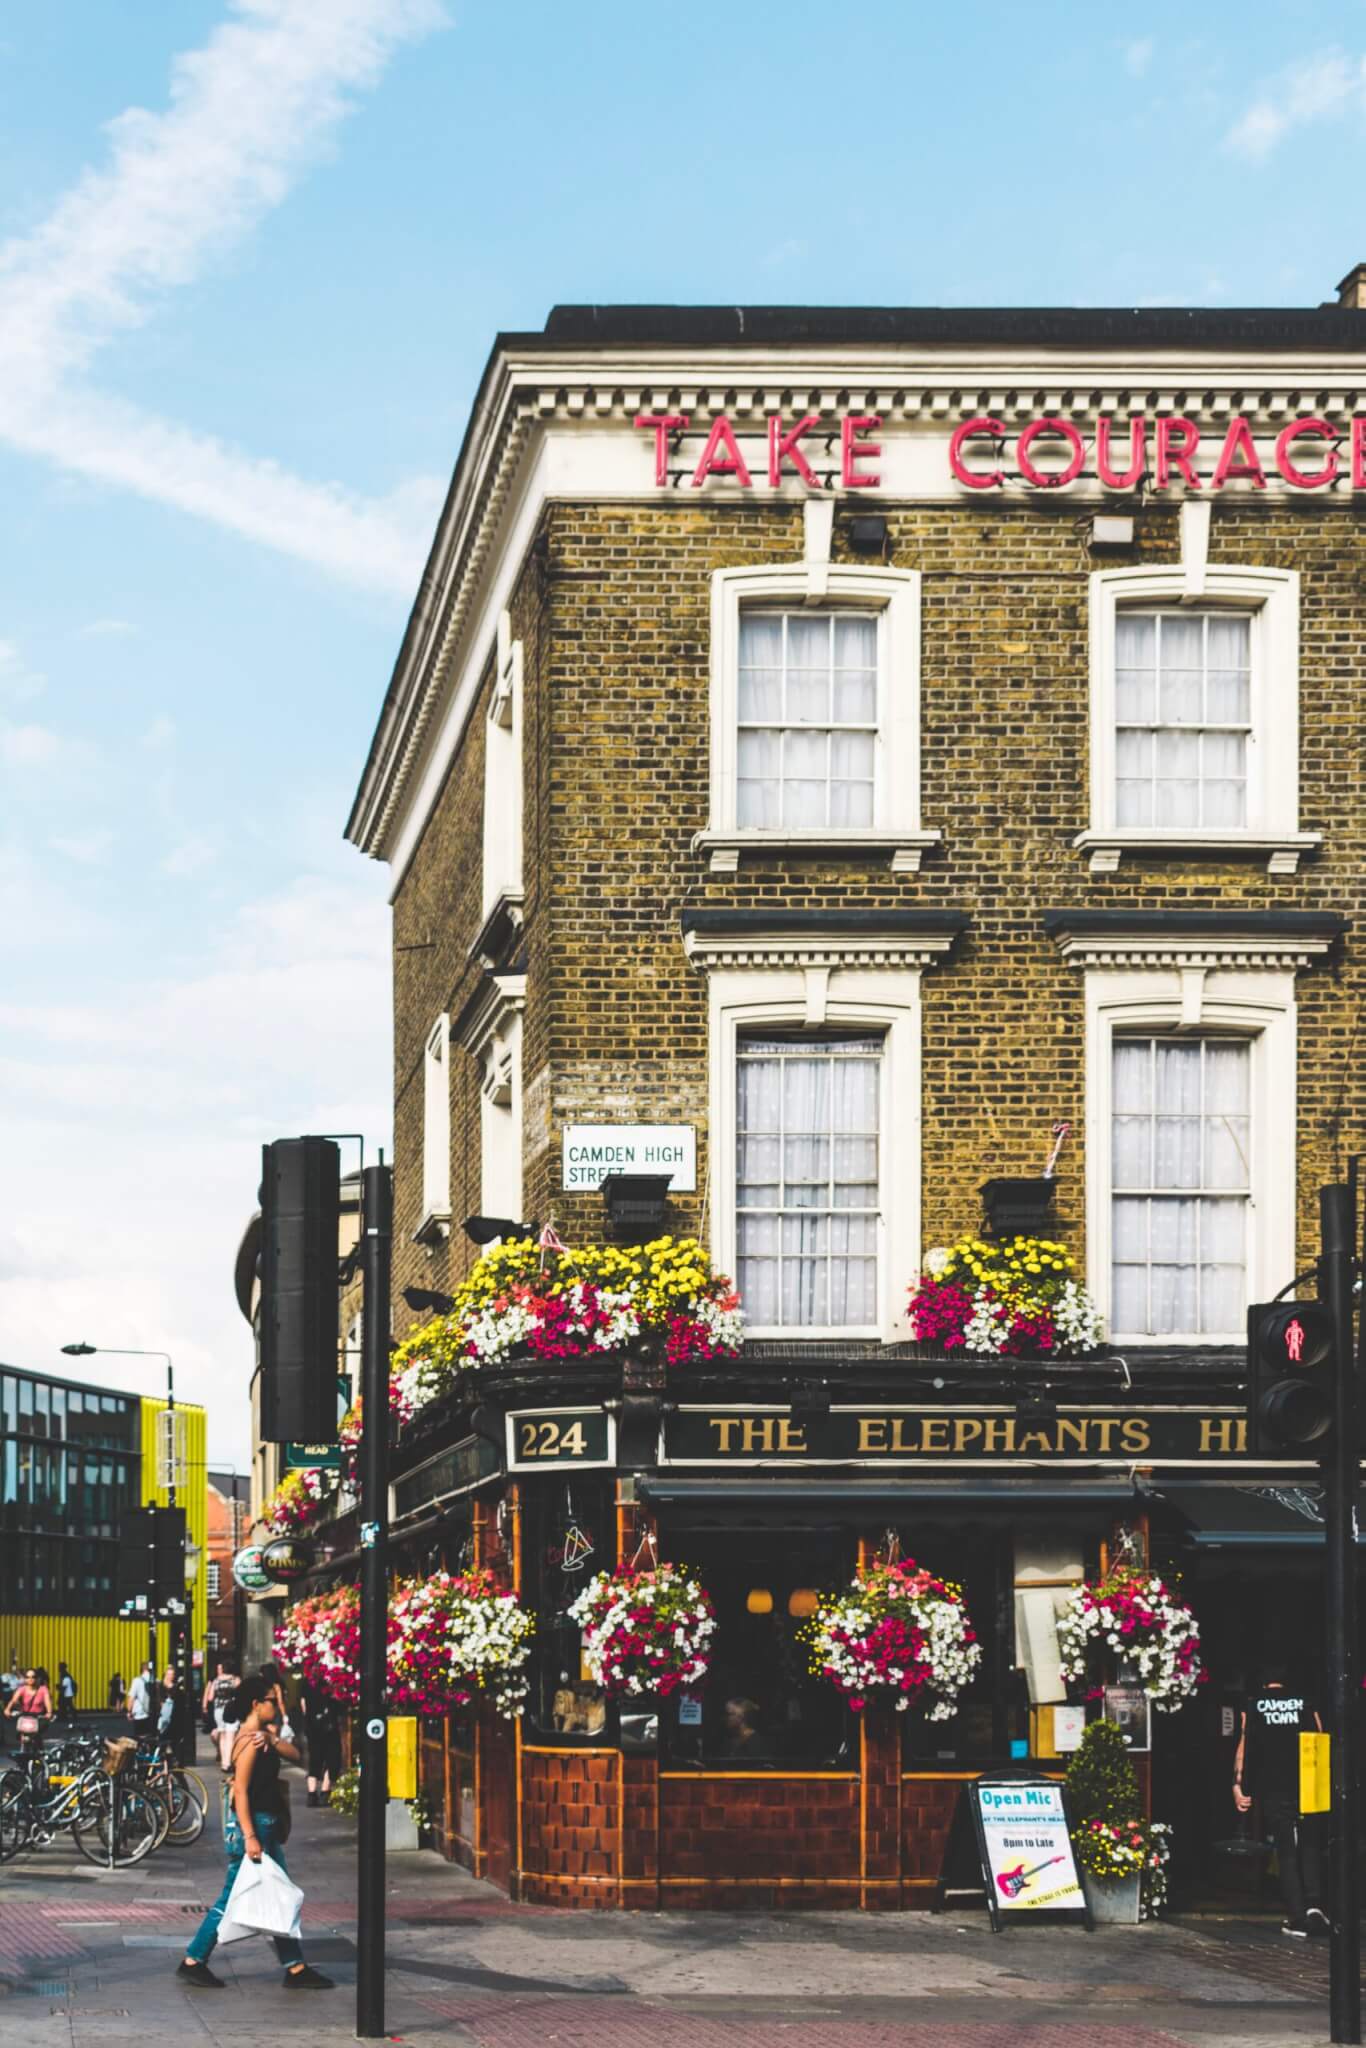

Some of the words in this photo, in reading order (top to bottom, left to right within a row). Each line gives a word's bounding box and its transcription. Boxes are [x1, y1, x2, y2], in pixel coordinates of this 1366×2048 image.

[634, 415, 882, 488] TAKE
[569, 1146, 635, 1162] CAMDEN
[645, 1147, 683, 1162] HIGH
[521, 1421, 587, 1456] 224
[709, 1418, 807, 1451] THE
[1256, 1698, 1304, 1713] CAMDEN
[1264, 1711, 1299, 1725] TOWN
[982, 1791, 1021, 1808] Open
[1026, 1791, 1051, 1805] Mic
[1025, 1838, 1034, 1847] to
[1035, 1838, 1055, 1848] Late
